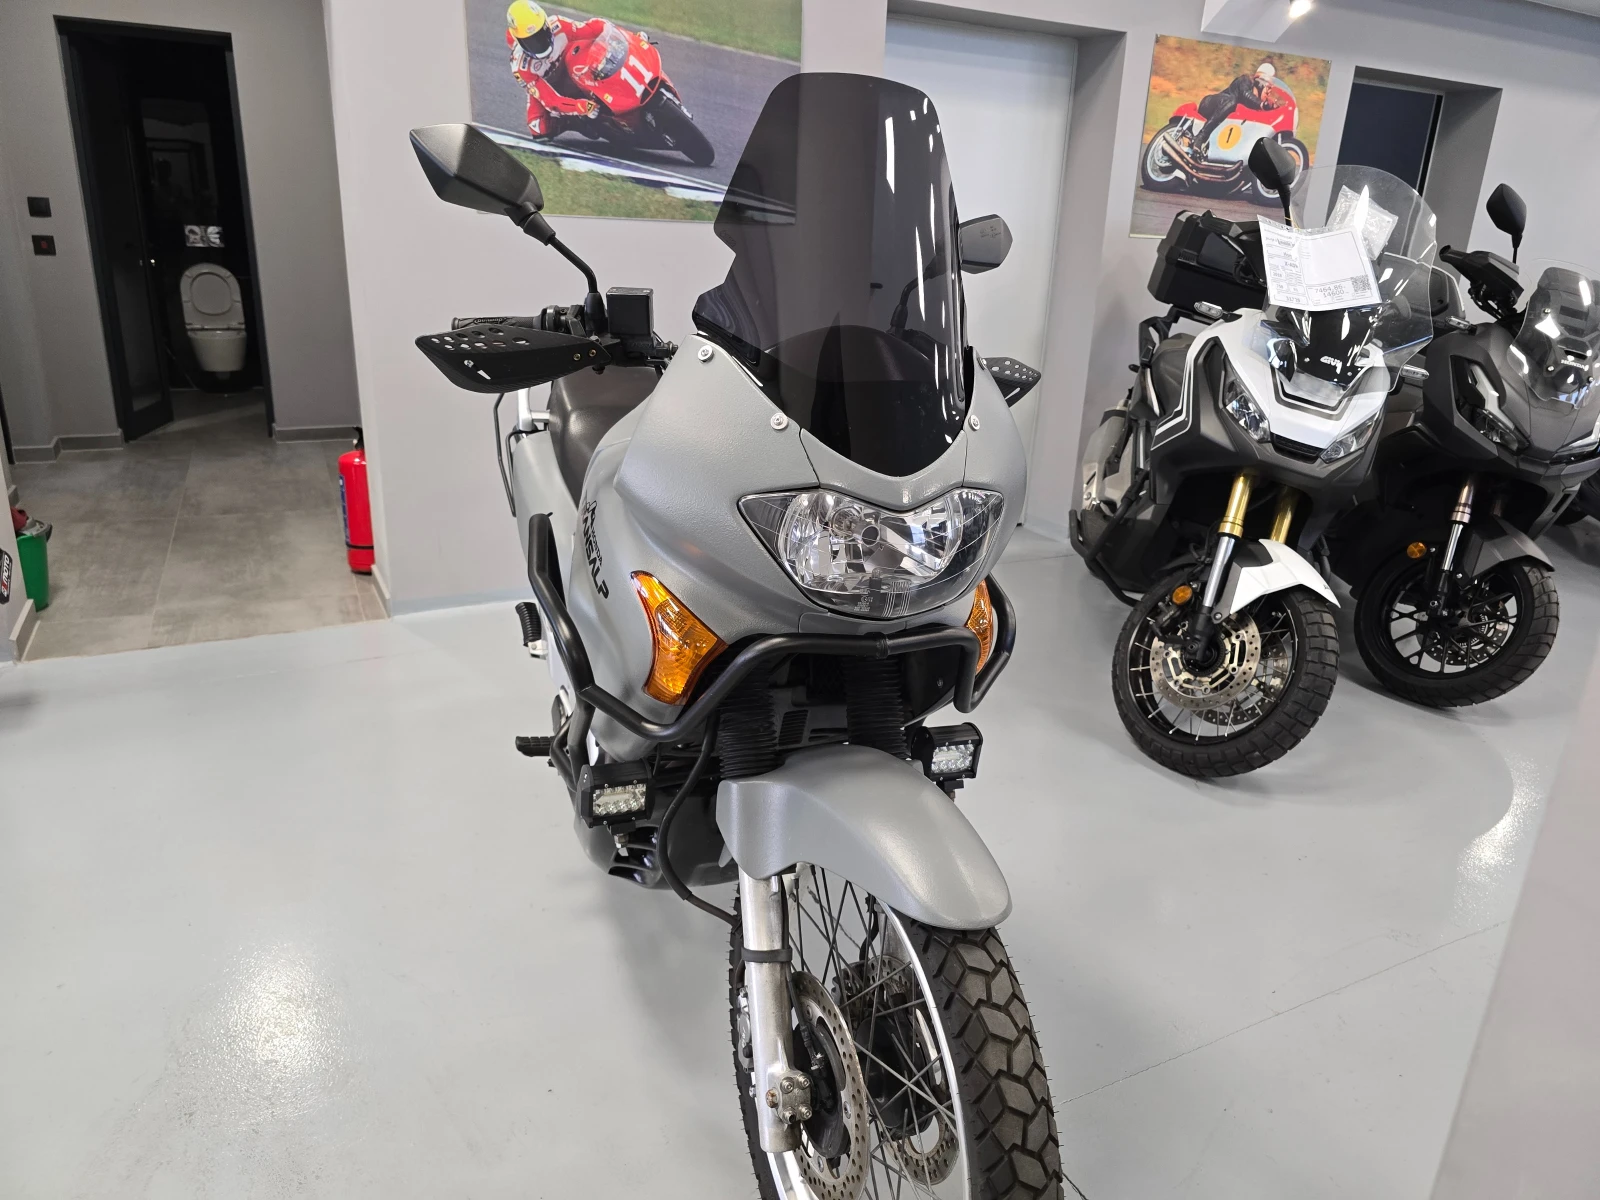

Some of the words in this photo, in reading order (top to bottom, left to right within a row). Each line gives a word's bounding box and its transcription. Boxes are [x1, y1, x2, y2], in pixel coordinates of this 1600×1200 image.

[621, 55, 653, 98] 11
[1226, 127, 1234, 144] 1
[1561, 360, 1585, 370] HONDA
